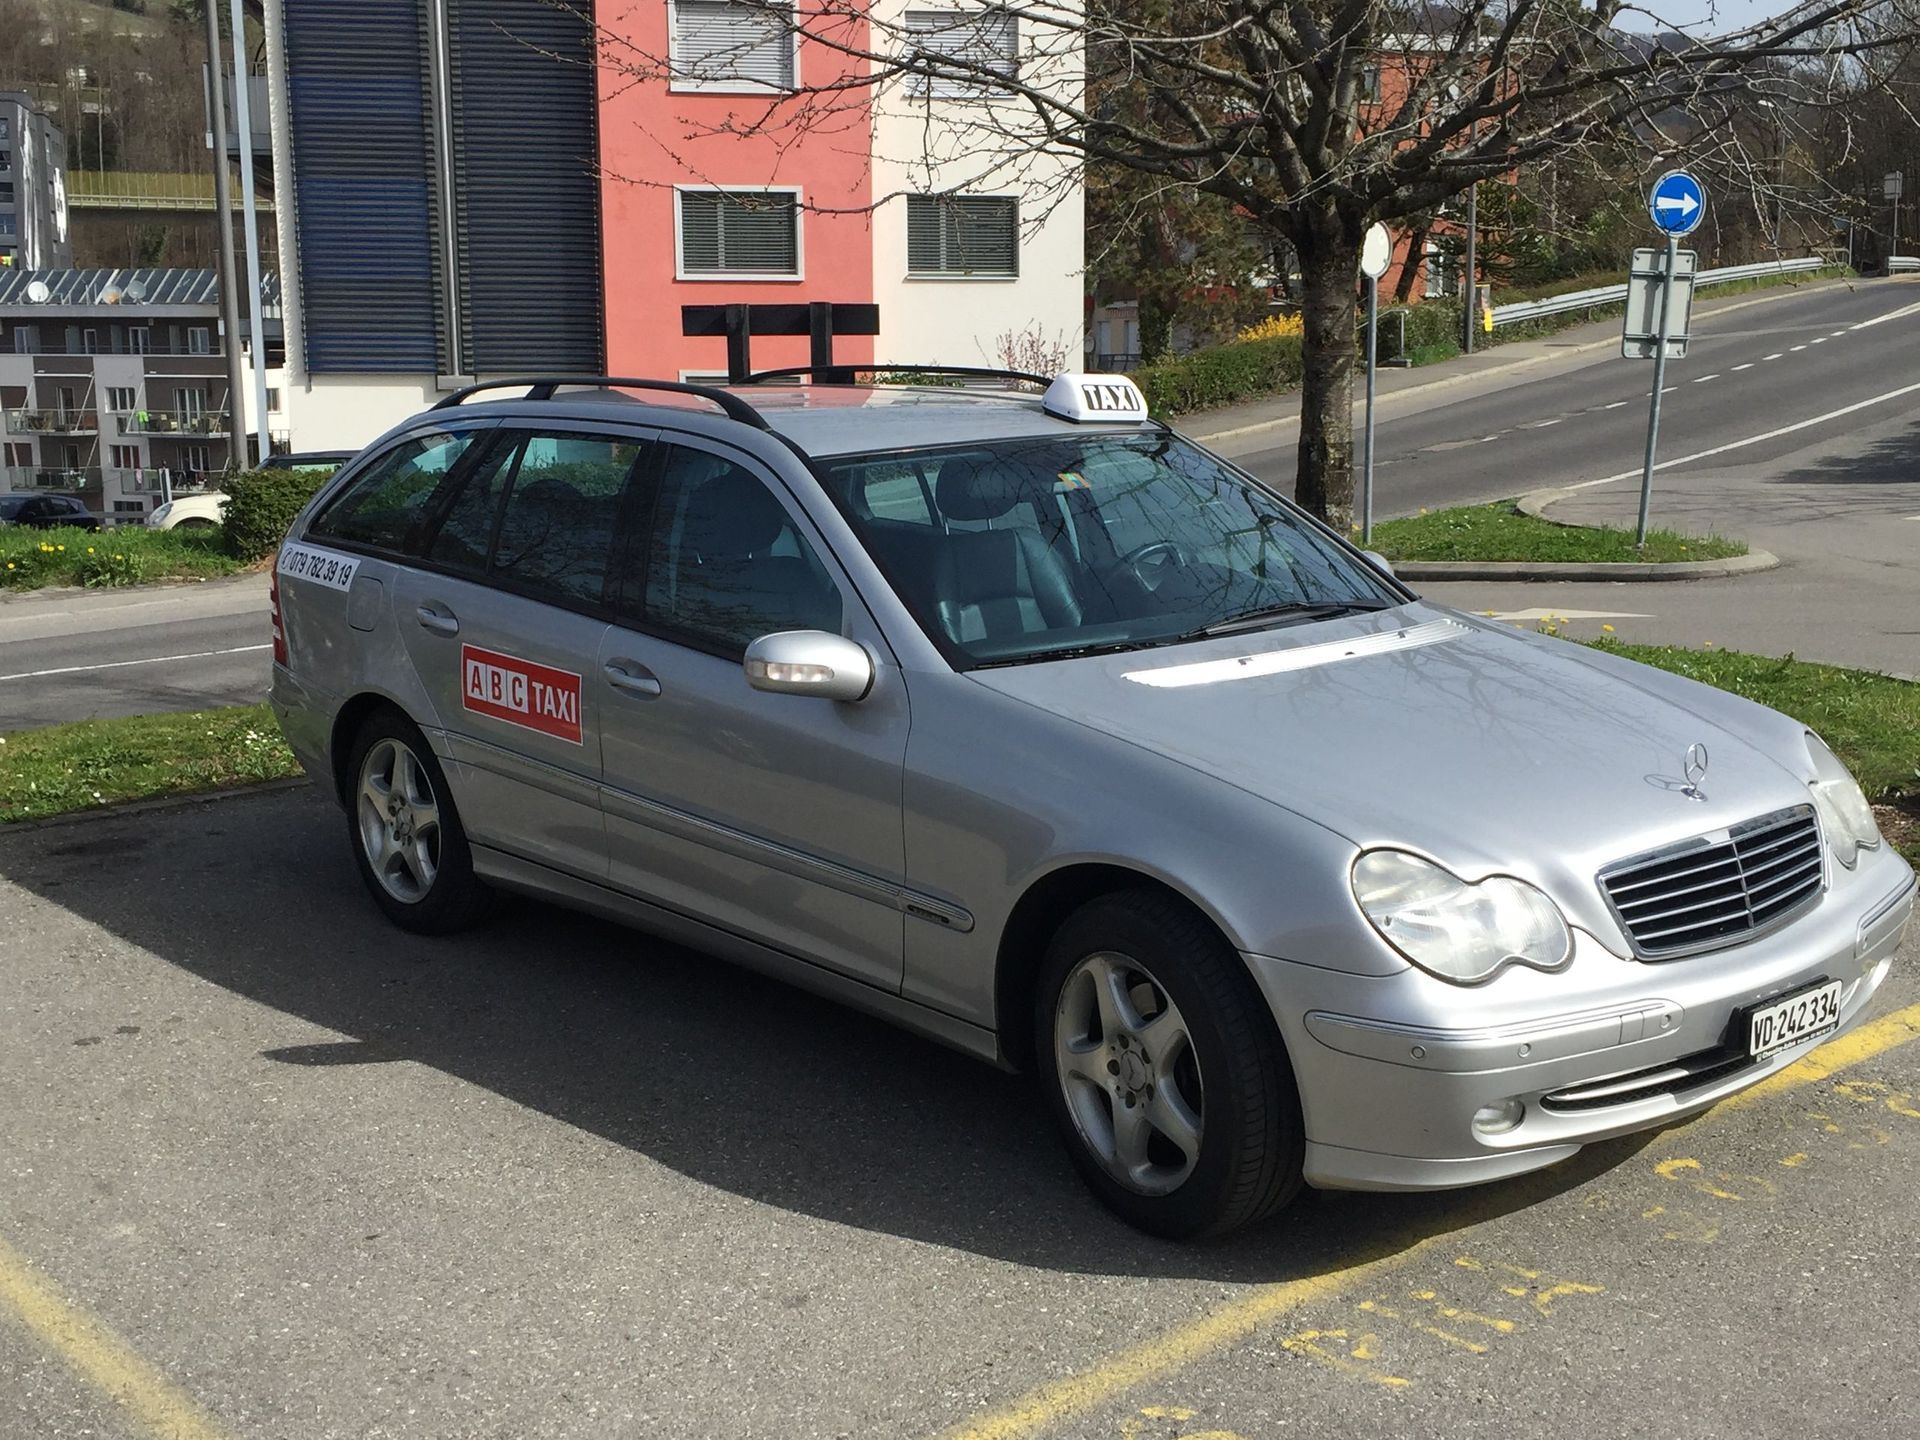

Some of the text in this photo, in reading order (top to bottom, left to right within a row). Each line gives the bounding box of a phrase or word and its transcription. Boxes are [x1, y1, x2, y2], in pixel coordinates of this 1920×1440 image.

[1082, 385, 1140, 411] TAXI
[289, 551, 353, 586] 079 782 39 19
[471, 665, 577, 724] ABC TAXI
